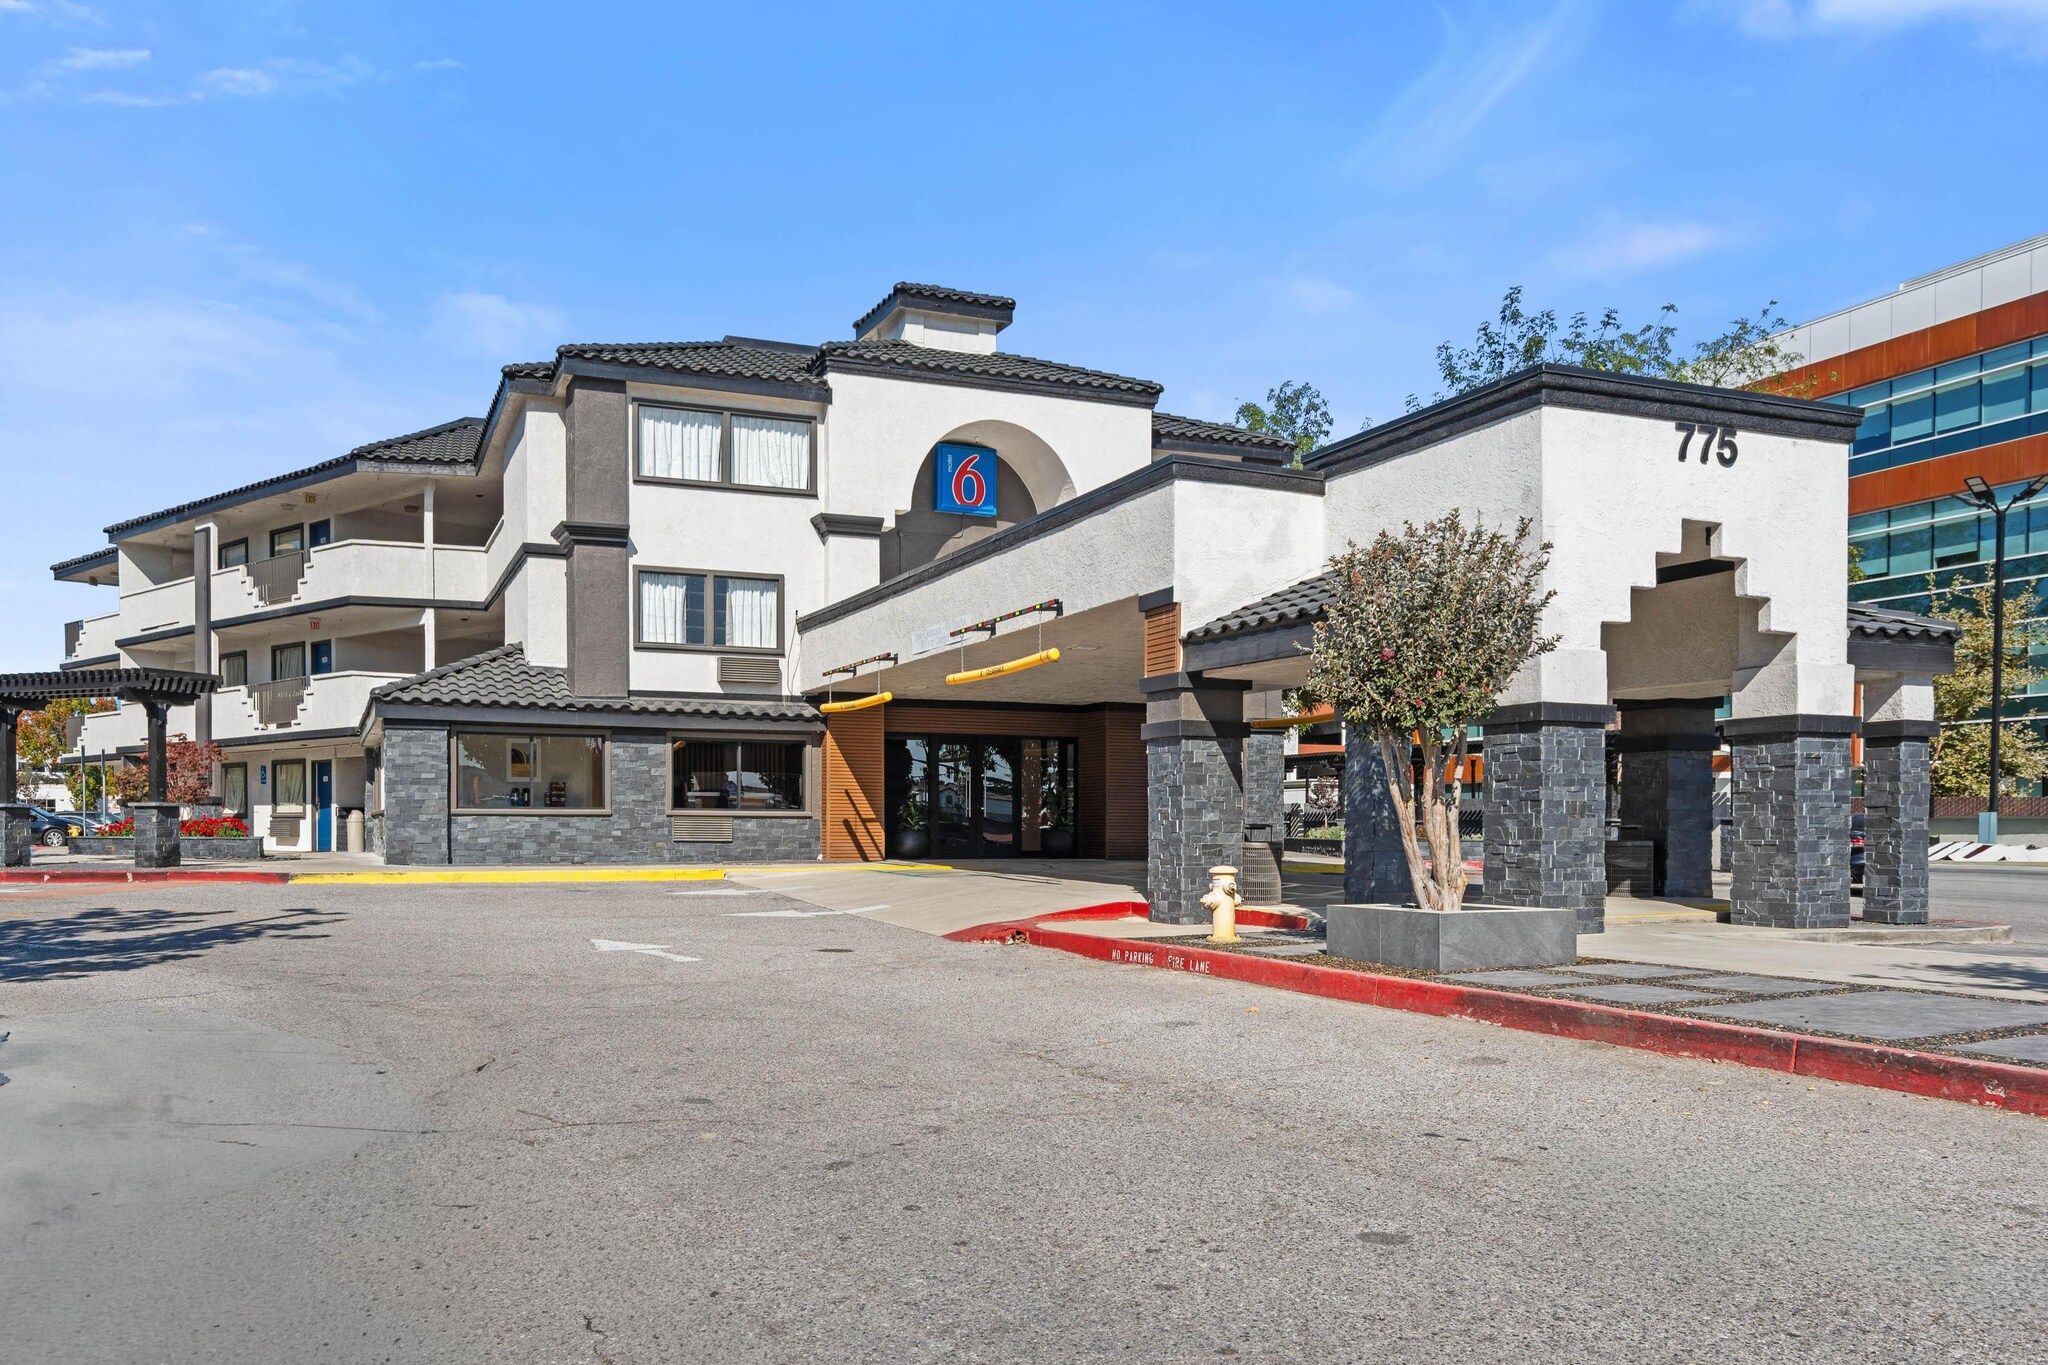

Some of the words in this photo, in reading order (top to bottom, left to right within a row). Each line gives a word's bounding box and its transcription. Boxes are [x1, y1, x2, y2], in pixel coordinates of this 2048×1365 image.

[1675, 422, 1738, 468] 775
[952, 453, 986, 507] 6
[1111, 949, 1121, 960] NO
[1124, 951, 1154, 964] PARKING
[1167, 955, 1185, 970] FIRE
[1189, 960, 1210, 973] LANE
